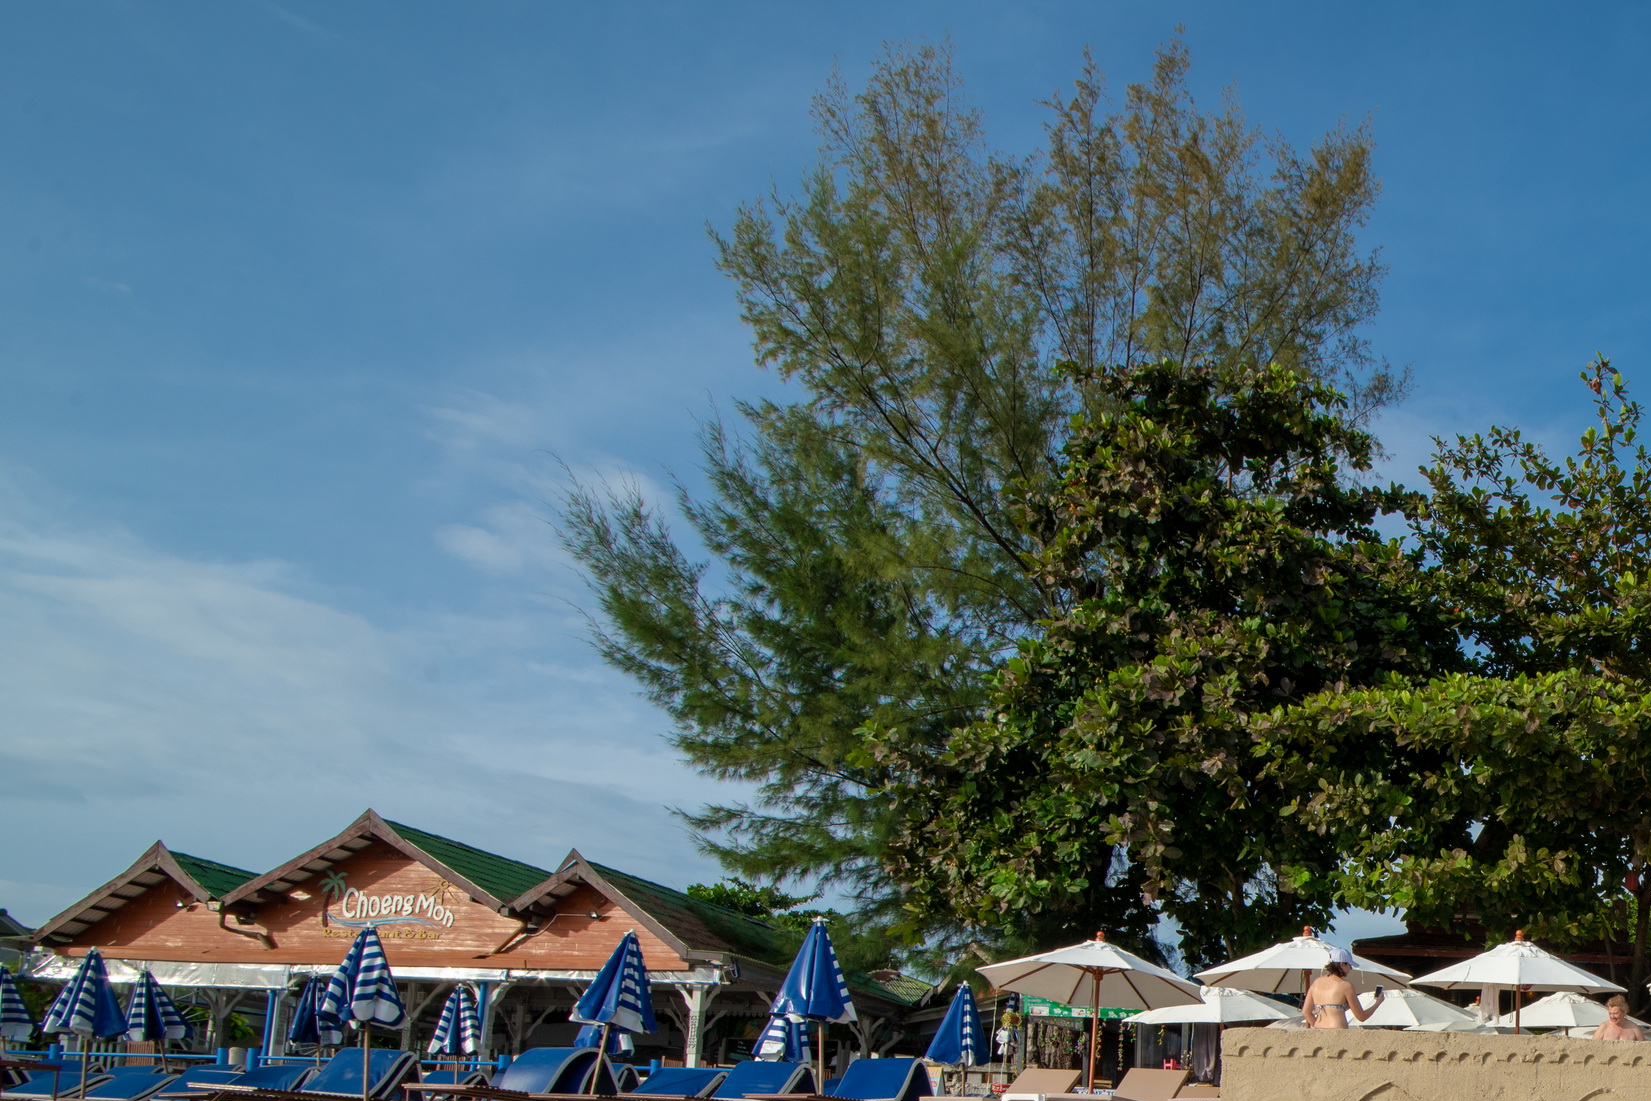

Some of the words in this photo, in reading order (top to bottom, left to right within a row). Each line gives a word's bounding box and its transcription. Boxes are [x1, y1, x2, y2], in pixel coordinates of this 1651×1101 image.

[342, 887, 414, 918] Choeng
[416, 894, 454, 927] Mon
[322, 928, 401, 939] Restaant
[404, 929, 417, 939] &
[419, 930, 442, 940] Bar
